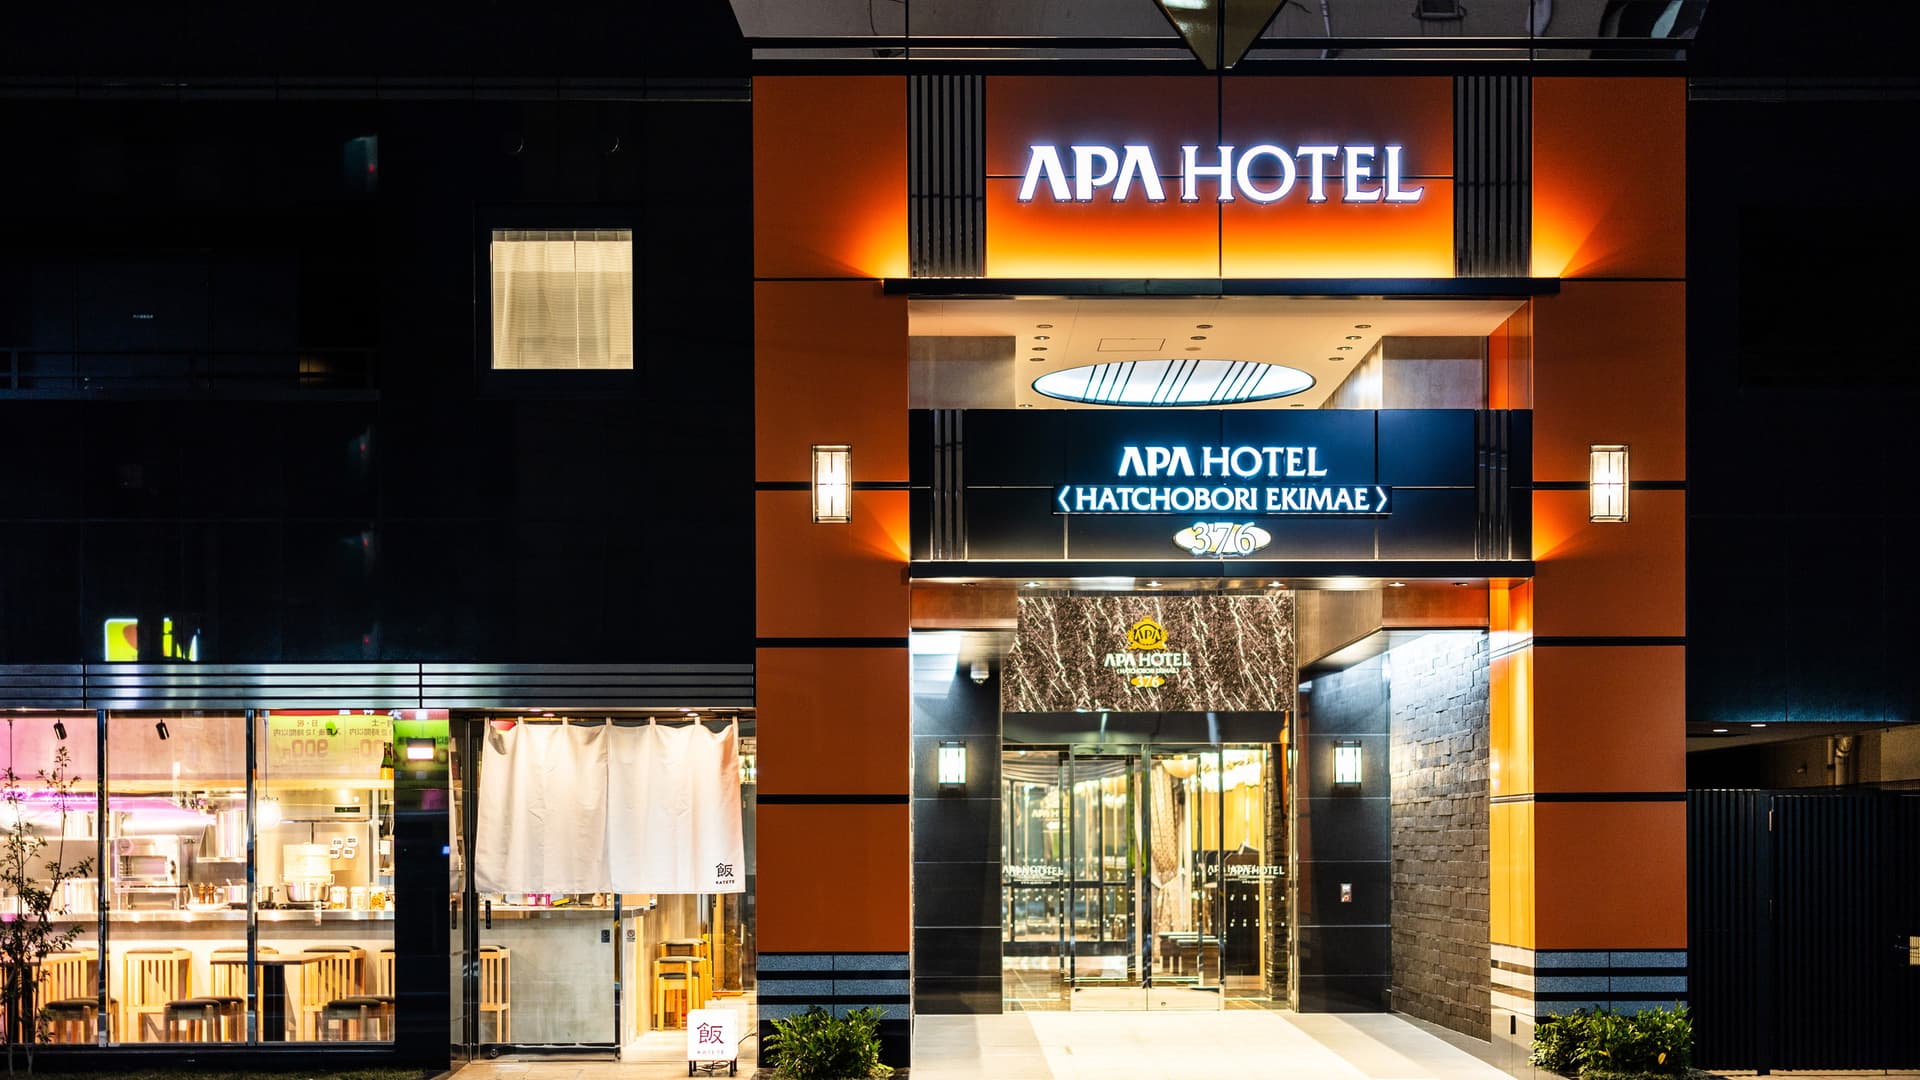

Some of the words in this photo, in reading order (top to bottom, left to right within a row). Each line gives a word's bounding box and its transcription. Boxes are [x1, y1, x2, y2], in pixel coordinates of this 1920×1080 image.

[1017, 144, 1166, 203] APA
[1181, 144, 1424, 203] HOTEL
[1118, 446, 1195, 477] APA
[1203, 446, 1328, 477] HOTEL
[1190, 521, 1256, 555] 376
[1134, 629, 1161, 640] APA
[1104, 653, 1137, 667] APA
[1139, 653, 1192, 667] HOTEL
[1136, 676, 1161, 688] 376
[715, 862, 734, 878] 飯
[697, 1022, 724, 1045] 飯
